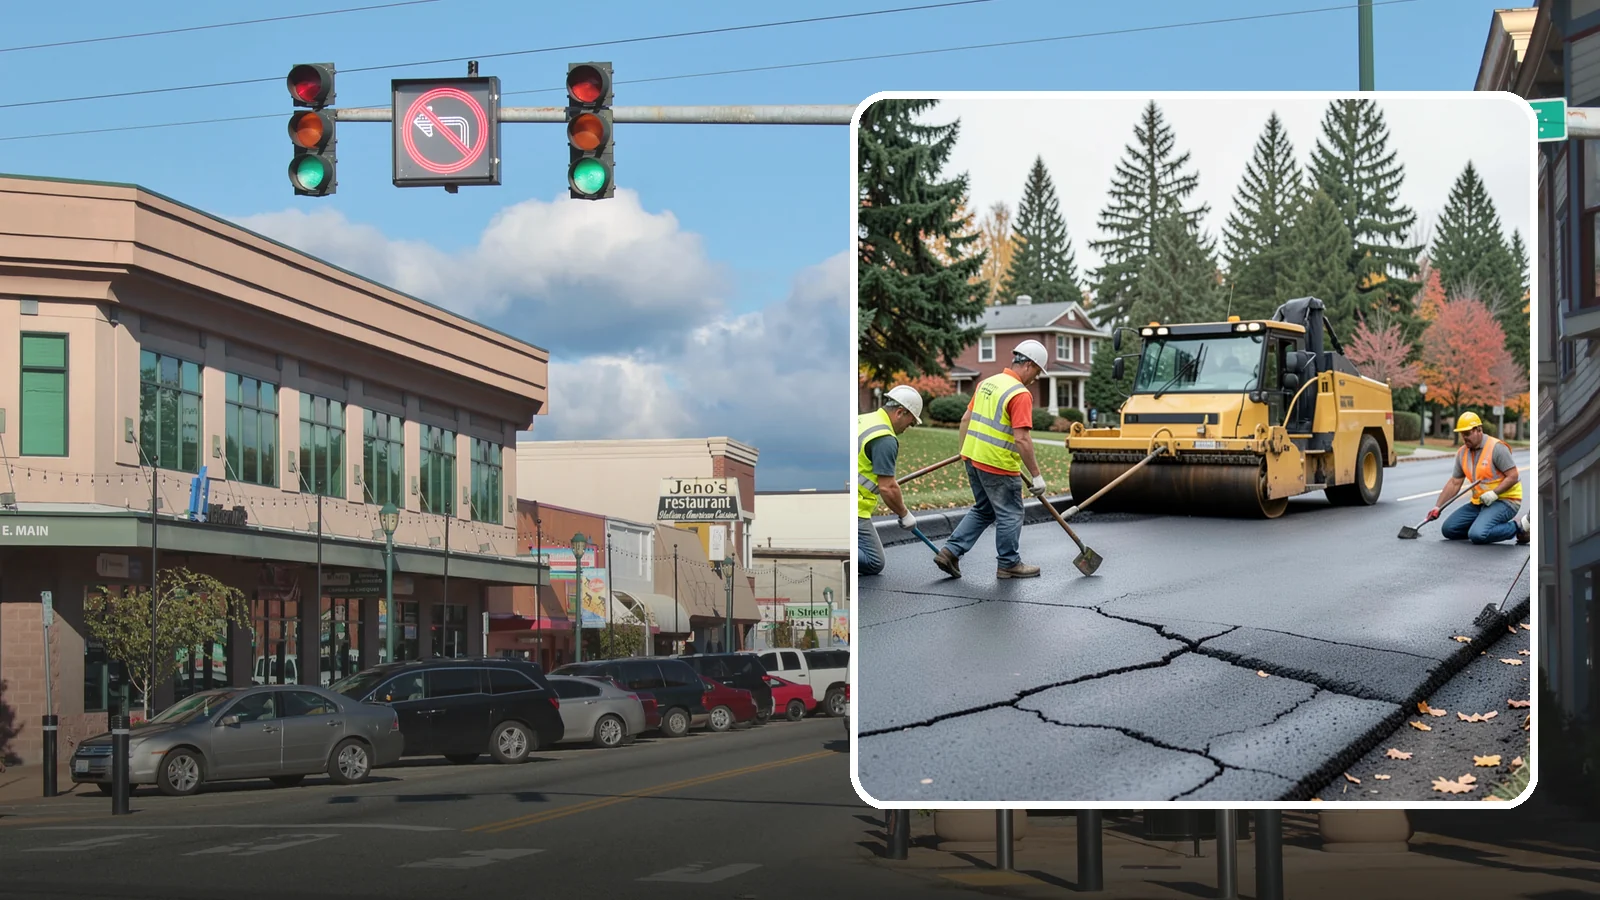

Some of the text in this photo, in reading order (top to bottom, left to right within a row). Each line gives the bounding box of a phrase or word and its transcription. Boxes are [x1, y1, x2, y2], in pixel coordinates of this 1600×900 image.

[669, 480, 728, 495] Jeno's
[665, 496, 731, 509] restaurant
[658, 510, 681, 520] Italian
[686, 510, 715, 519] American
[715, 510, 737, 519] Cuisine
[2, 525, 49, 536] E. MAIN
[797, 608, 828, 616] Street
